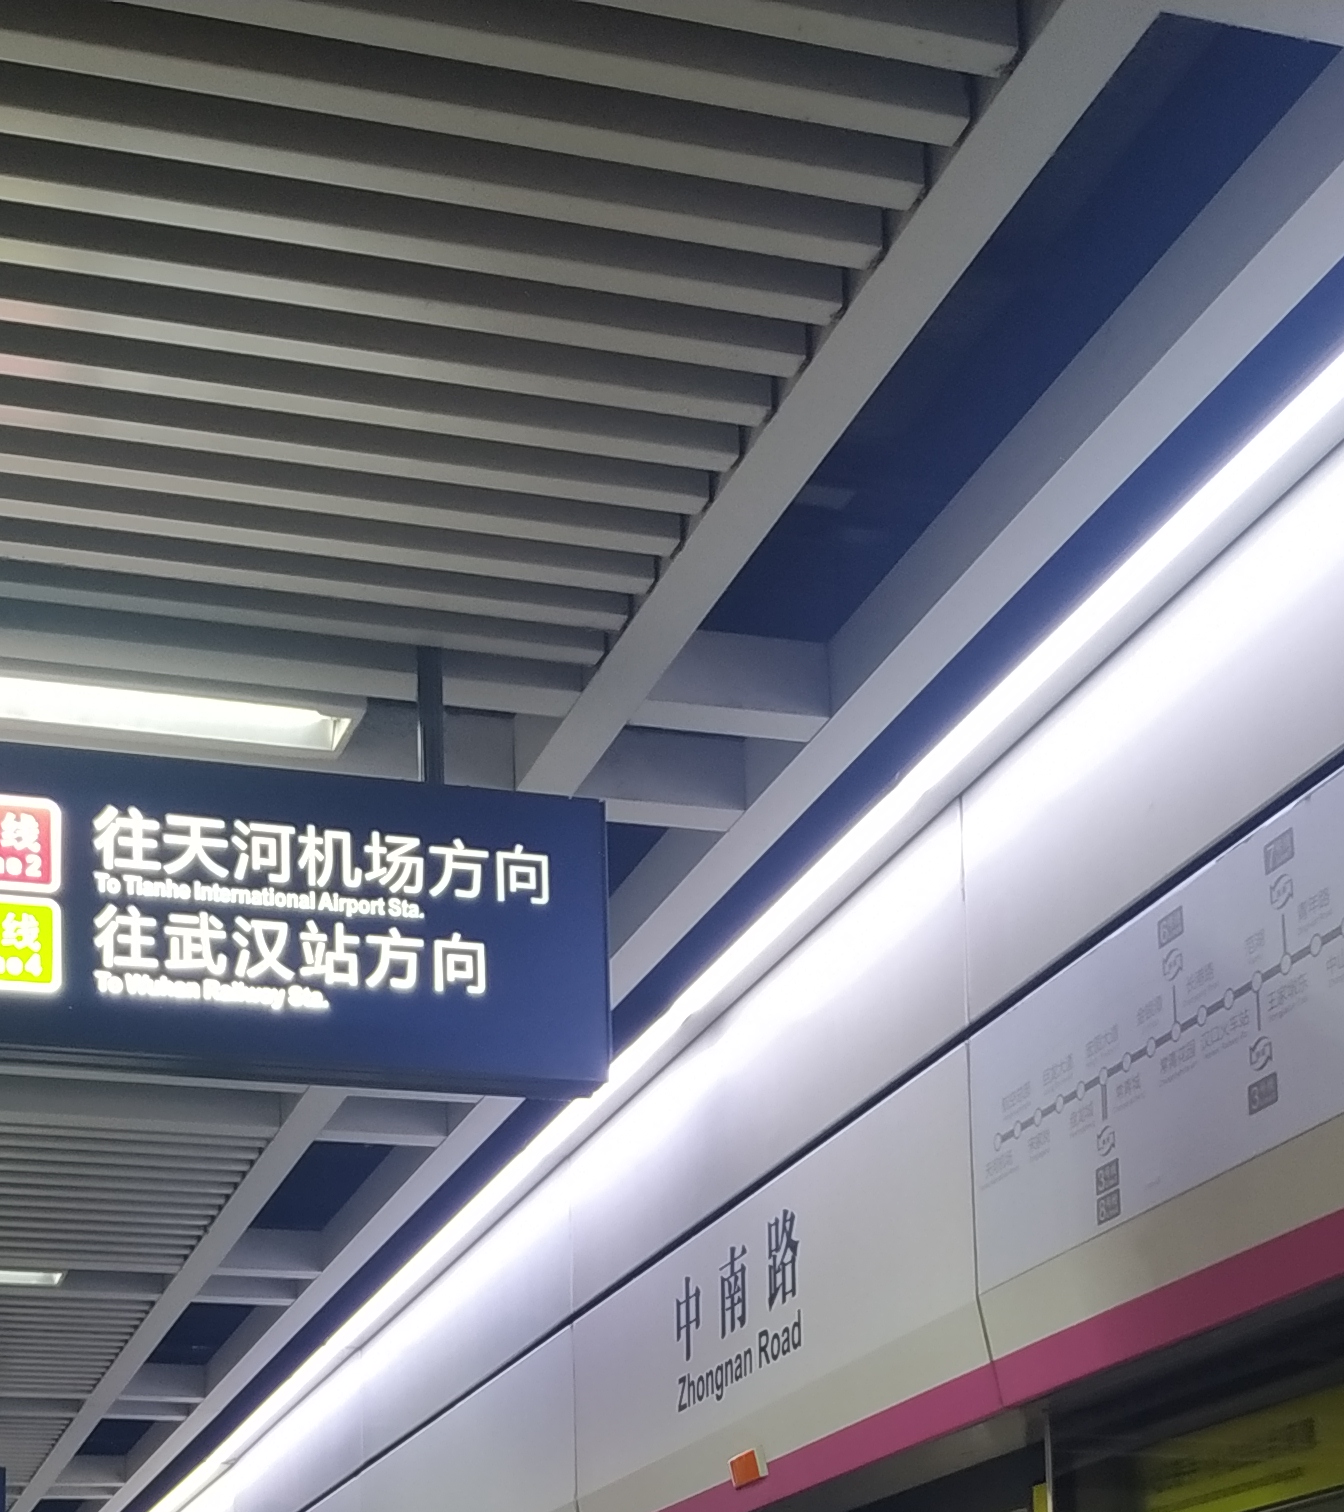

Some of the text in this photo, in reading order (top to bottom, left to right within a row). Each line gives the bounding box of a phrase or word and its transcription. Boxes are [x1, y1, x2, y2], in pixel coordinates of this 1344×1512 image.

[91, 804, 551, 906] 往天河机场方向
[93, 870, 425, 919] To Tianhe International Airport Sta.
[92, 969, 123, 993] To
[93, 904, 489, 997] 往武汉站方向
[675, 1208, 800, 1362] 中南路
[677, 1308, 802, 1413] Zhongnan Road
